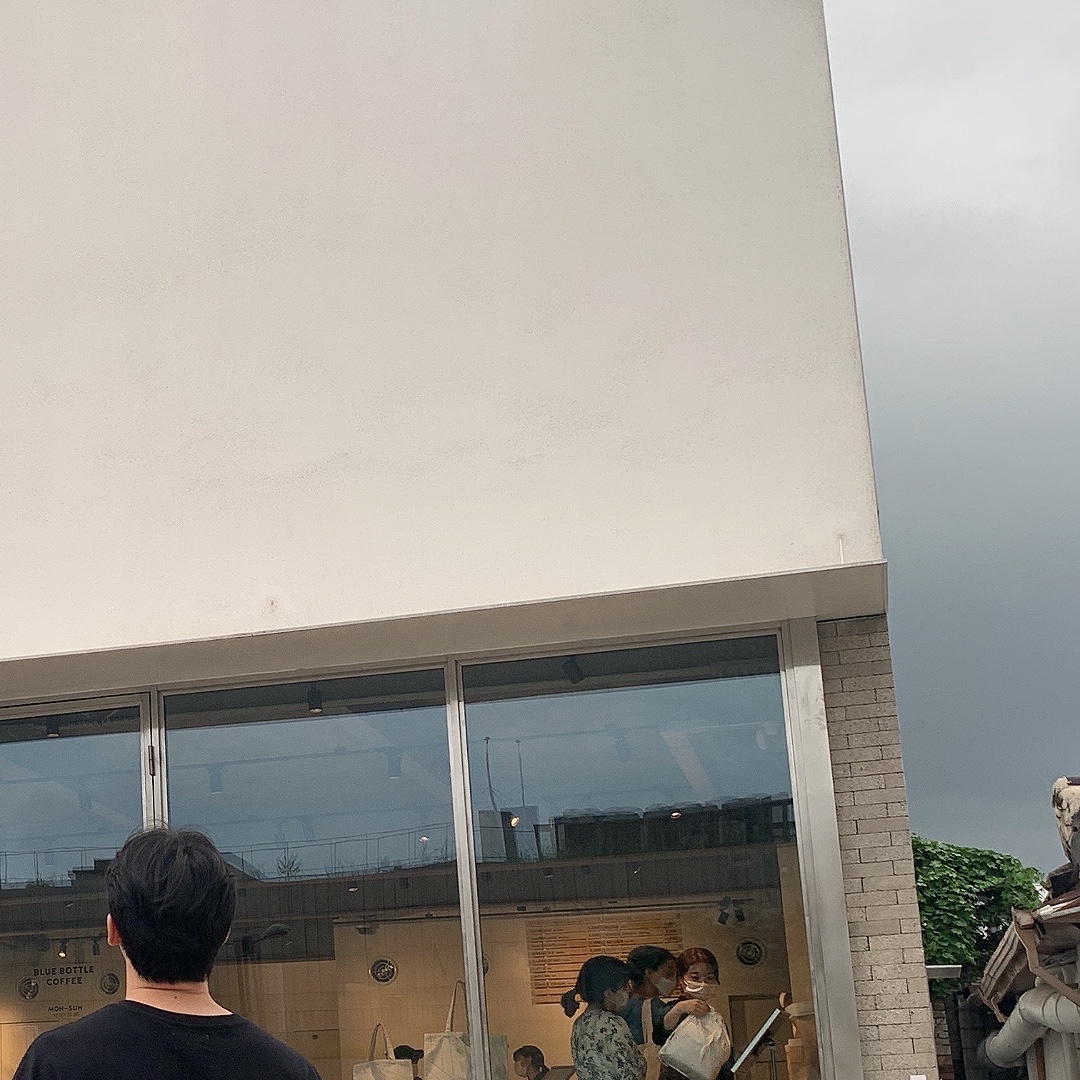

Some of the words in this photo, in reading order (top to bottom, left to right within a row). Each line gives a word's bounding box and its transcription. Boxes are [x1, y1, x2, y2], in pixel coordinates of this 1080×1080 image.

[33, 967, 57, 976] BLUE
[60, 965, 95, 975] BOTTLE
[46, 977, 83, 986] COFFEE
